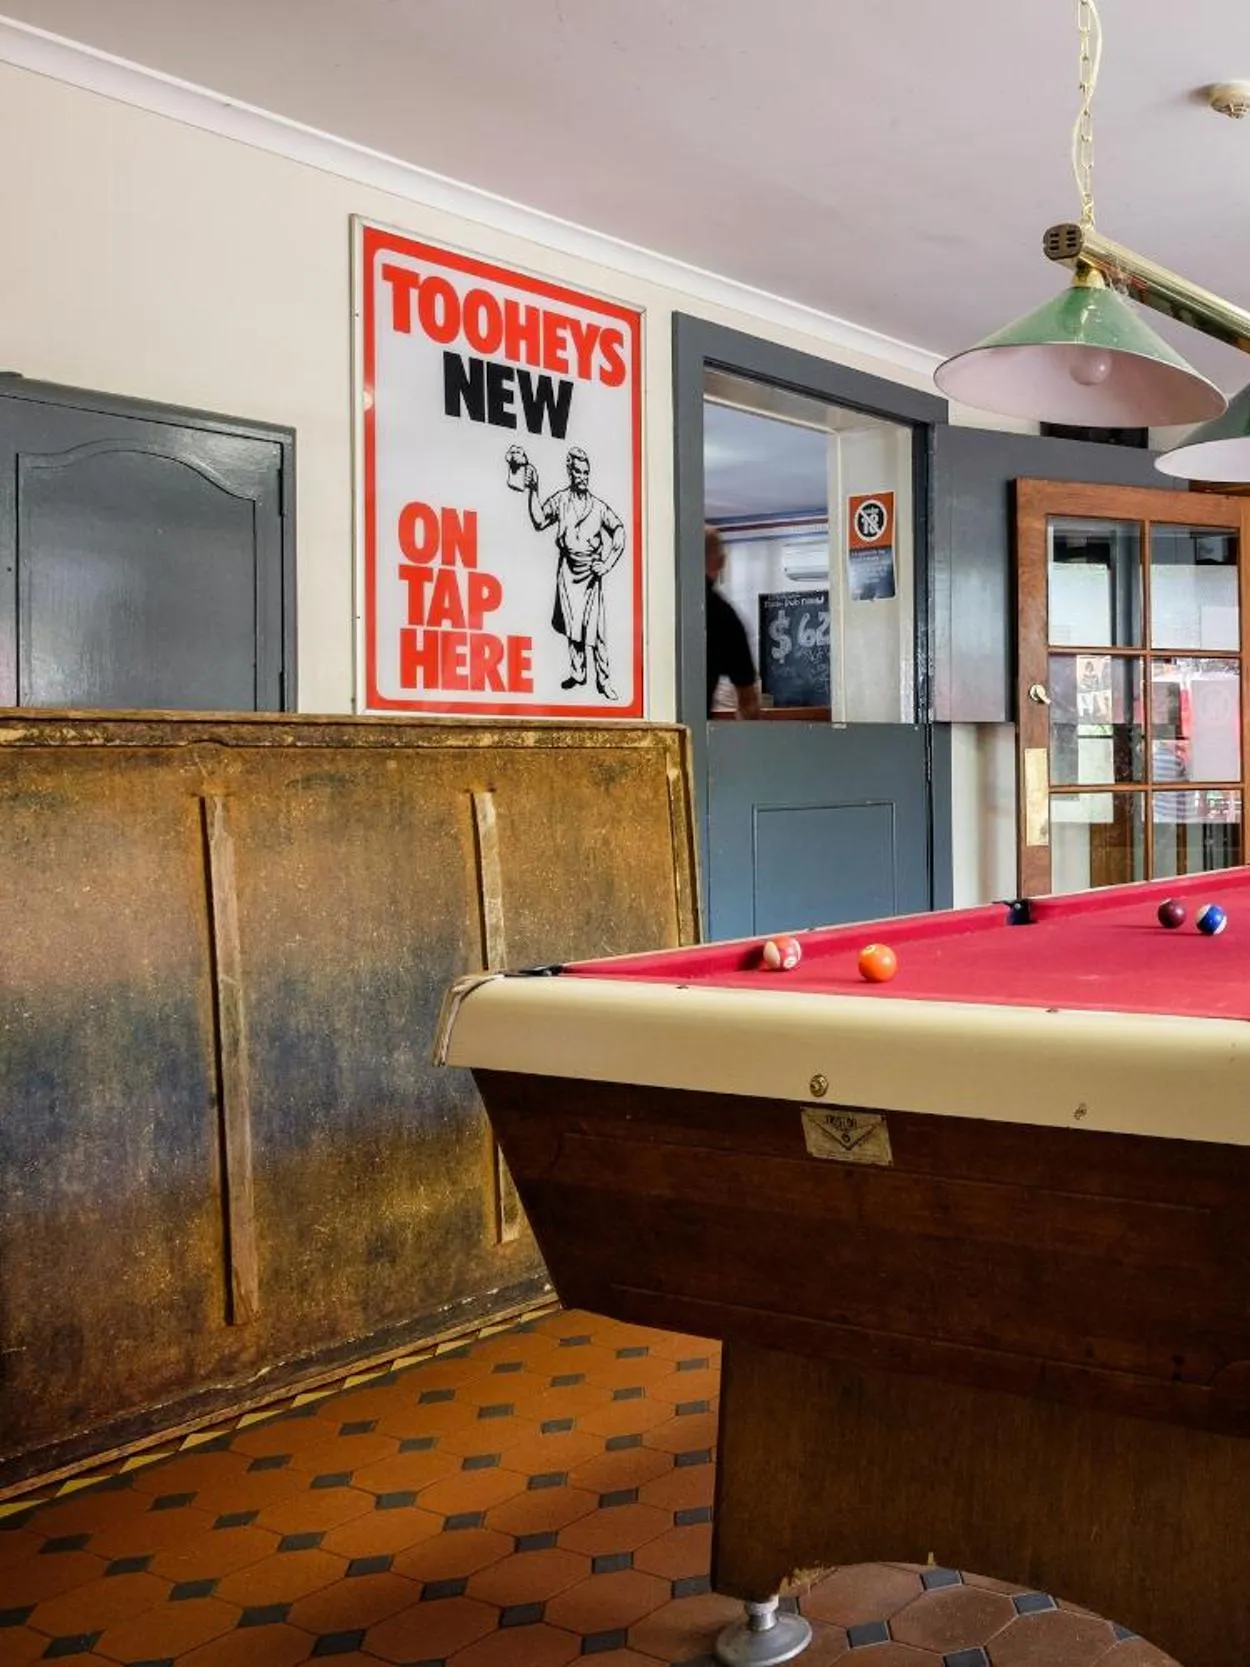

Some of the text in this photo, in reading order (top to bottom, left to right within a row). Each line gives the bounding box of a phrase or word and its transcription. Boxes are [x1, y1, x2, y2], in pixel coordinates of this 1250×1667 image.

[382, 263, 626, 387] TOOHEYS
[443, 351, 574, 439] NEW
[398, 501, 477, 568] ON
[399, 564, 502, 630] TAP
[400, 628, 534, 693] HERE
